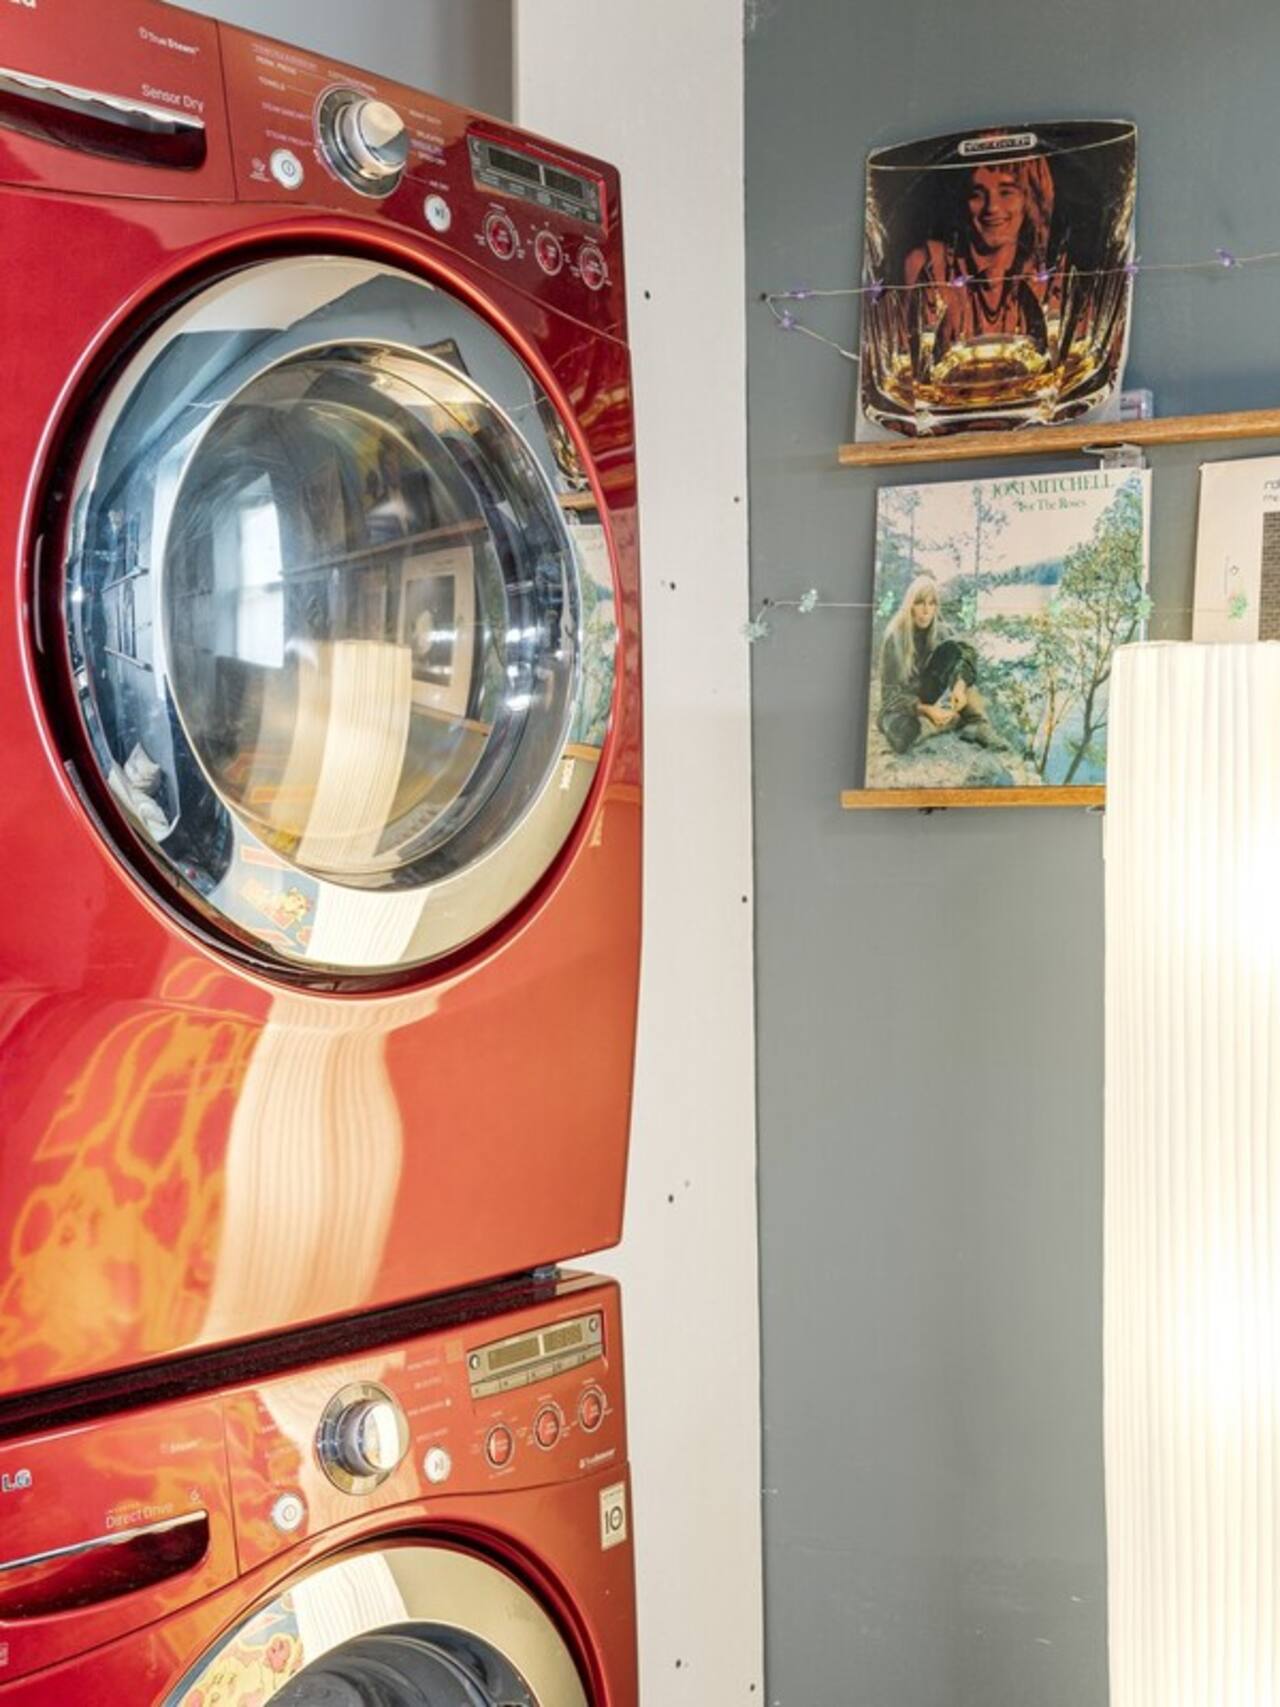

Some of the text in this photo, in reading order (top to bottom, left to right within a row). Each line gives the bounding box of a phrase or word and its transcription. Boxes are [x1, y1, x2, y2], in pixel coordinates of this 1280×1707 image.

[141, 84, 204, 113] Sensor Dry
[992, 473, 1111, 499] JONI MITCHELL
[2, 1468, 33, 1492] LG
